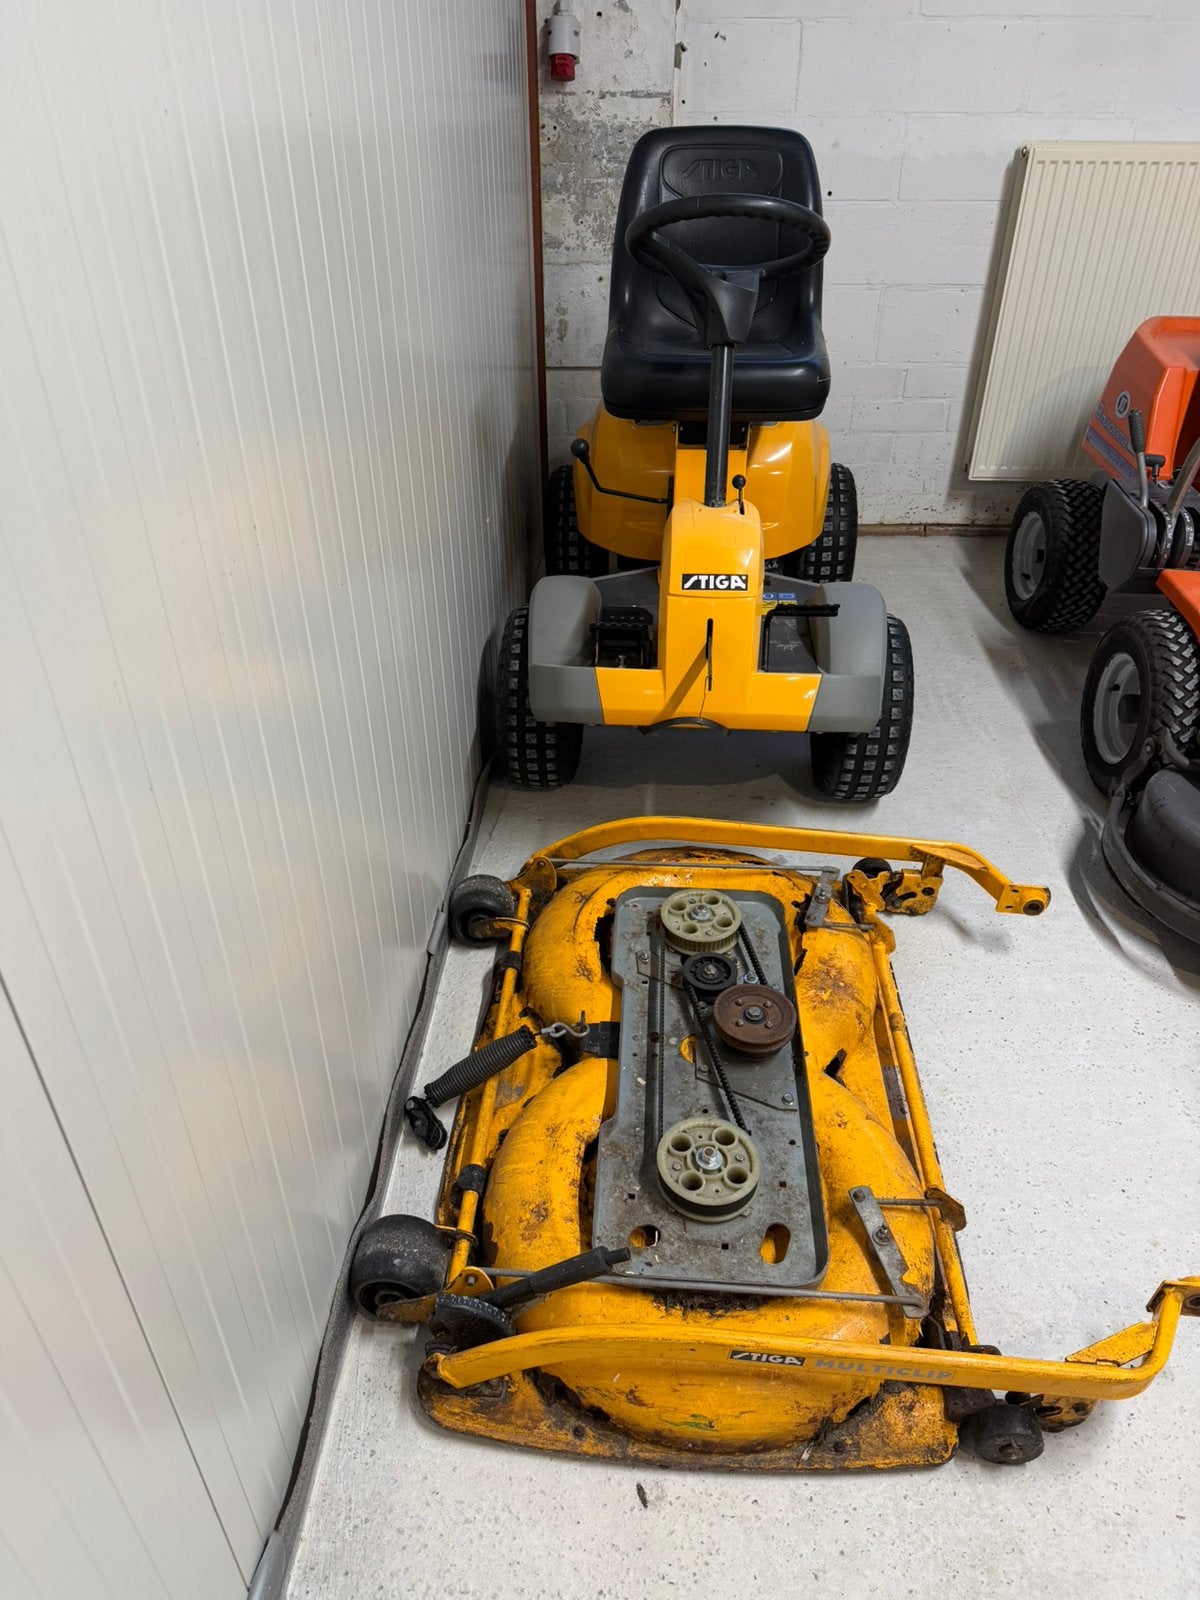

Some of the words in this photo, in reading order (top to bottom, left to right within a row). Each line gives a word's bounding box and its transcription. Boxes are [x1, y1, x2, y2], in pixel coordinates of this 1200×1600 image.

[682, 158, 760, 180] STIGA
[683, 575, 747, 589] STIGA
[732, 1352, 802, 1366] STIGA
[815, 1360, 952, 1379] MULTICLIP
